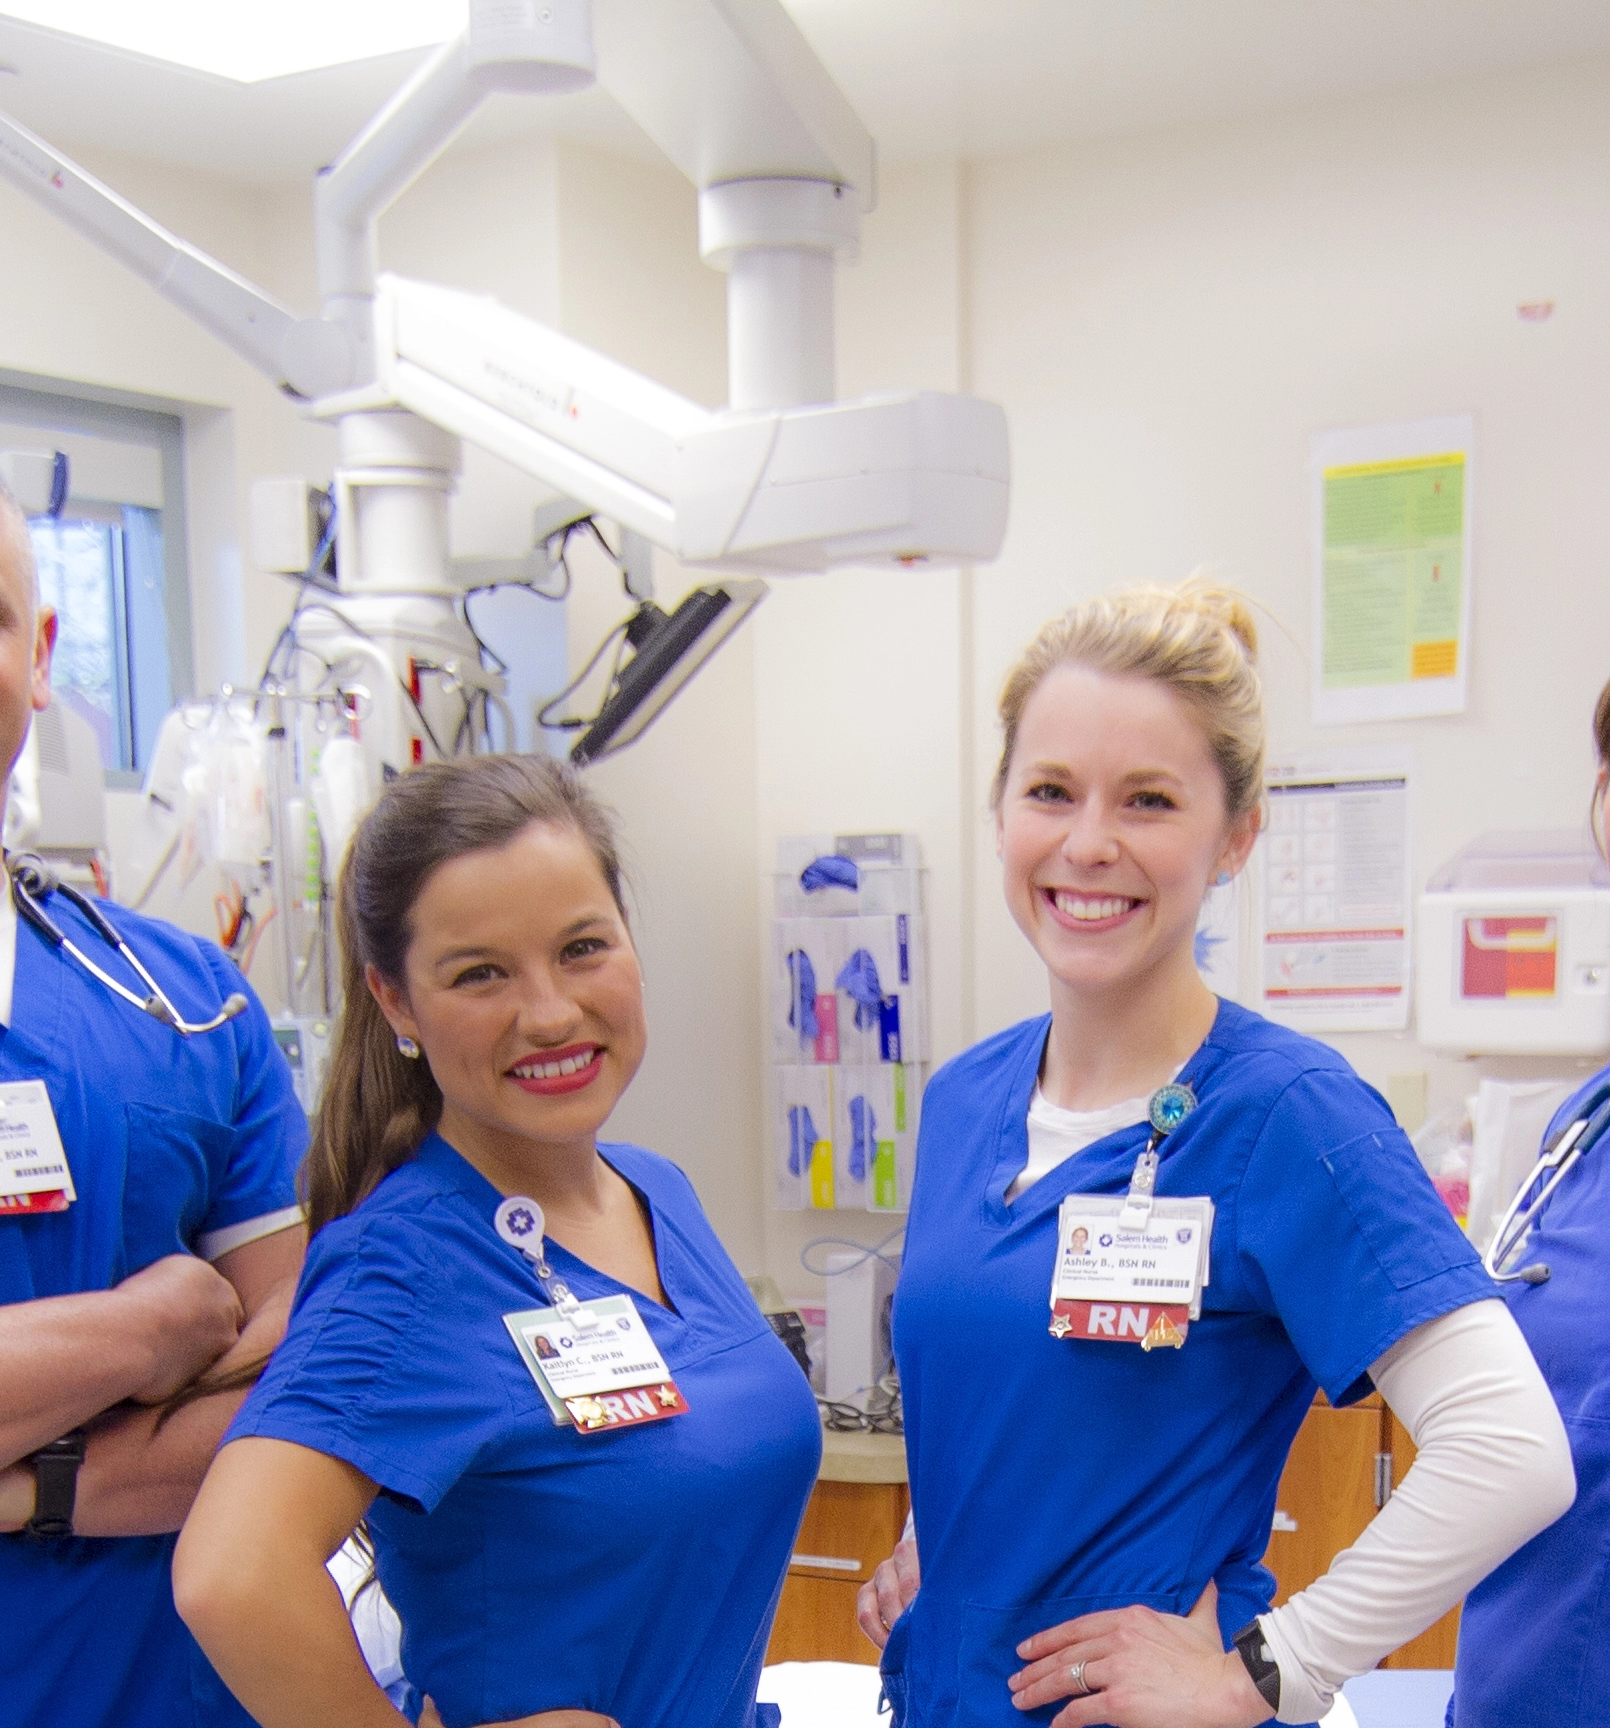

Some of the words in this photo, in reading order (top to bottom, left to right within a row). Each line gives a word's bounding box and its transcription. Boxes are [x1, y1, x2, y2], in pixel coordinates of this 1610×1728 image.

[1063, 1258, 1097, 1269] Ashley
[1118, 1259, 1138, 1268] BSN
[1141, 1260, 1156, 1269] RN
[1087, 1305, 1150, 1337] RN
[603, 1391, 657, 1424] RN
